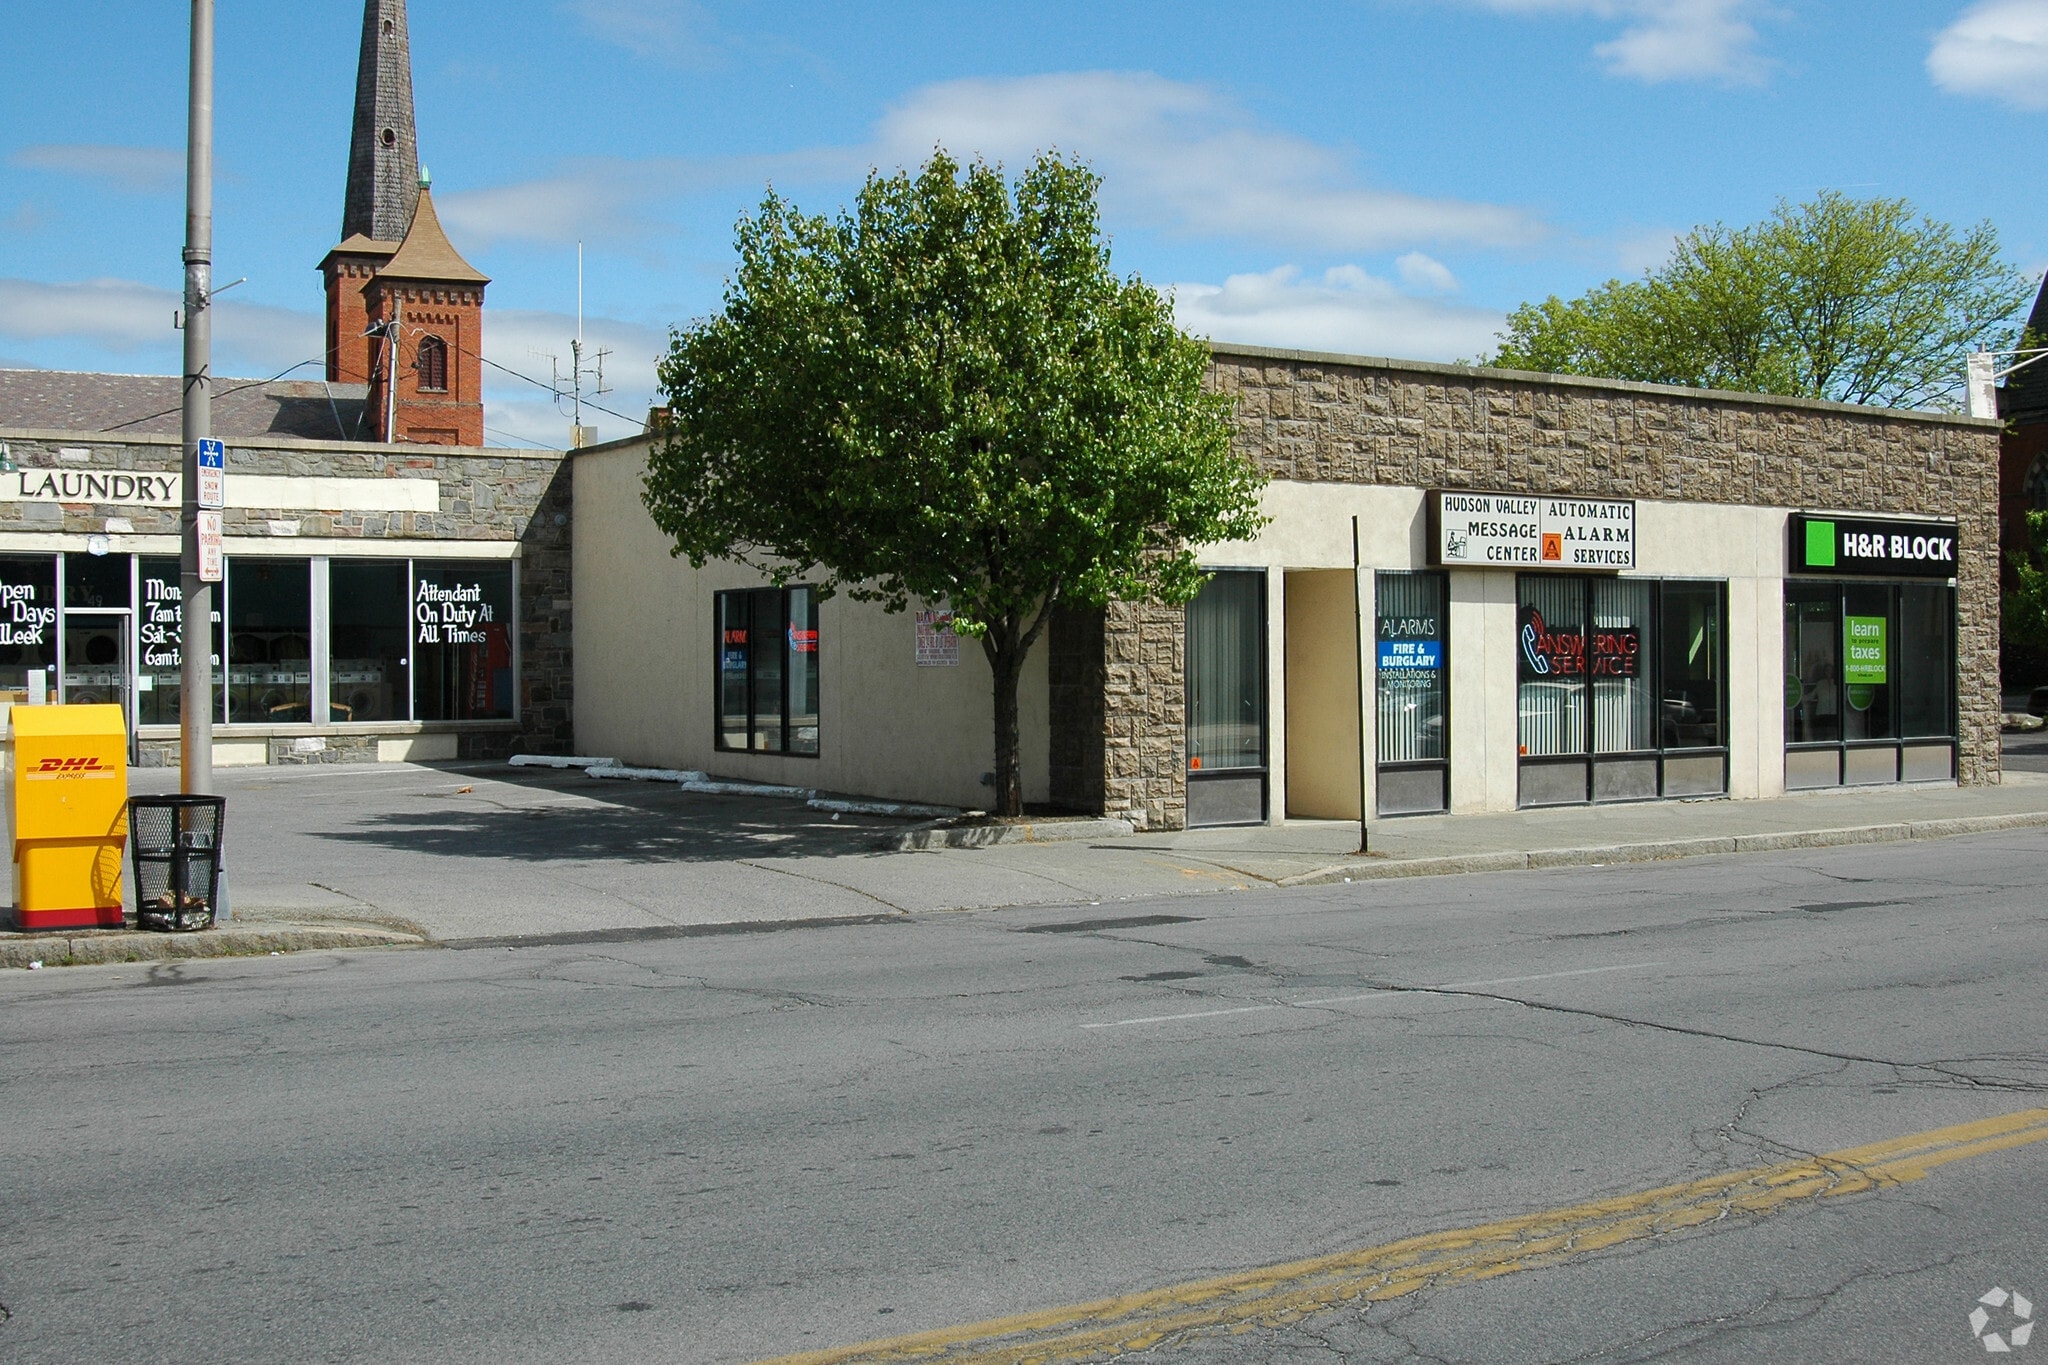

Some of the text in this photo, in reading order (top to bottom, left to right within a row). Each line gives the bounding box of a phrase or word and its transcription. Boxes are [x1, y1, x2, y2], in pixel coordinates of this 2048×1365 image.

[19, 471, 177, 500] LAUNDRY
[204, 481, 218, 490] SNOW
[203, 491, 219, 501] ROUTE
[1445, 496, 1537, 515] HUDSON VALLEY
[1549, 502, 1630, 520] AUTOMATIC
[207, 519, 217, 531] NO
[1468, 522, 1537, 539] MESSAGE
[201, 533, 221, 546] PARKING
[1563, 526, 1630, 543] ALARM
[1487, 545, 1537, 561] CENTER
[1844, 532, 1952, 561] H&R BLOCK
[207, 557, 218, 567] TIME
[1573, 549, 1630, 564] SERVICES
[0, 577, 35, 608] pen
[416, 579, 481, 602] Attendant
[11, 600, 56, 629] Days
[145, 601, 174, 622] 7am
[416, 602, 494, 628] On Duty At
[418, 623, 487, 644] All Times
[1381, 618, 1435, 636] ALARMS
[1851, 619, 1880, 637] learn
[145, 644, 172, 666] 6am
[1393, 643, 1425, 654] FIRE &
[1850, 645, 1880, 660] taxes
[1382, 655, 1436, 667] BURGLARY
[1381, 670, 1430, 680] INSTALLATIONS
[1387, 679, 1432, 689] MONITORING
[38, 757, 103, 772] DHL
